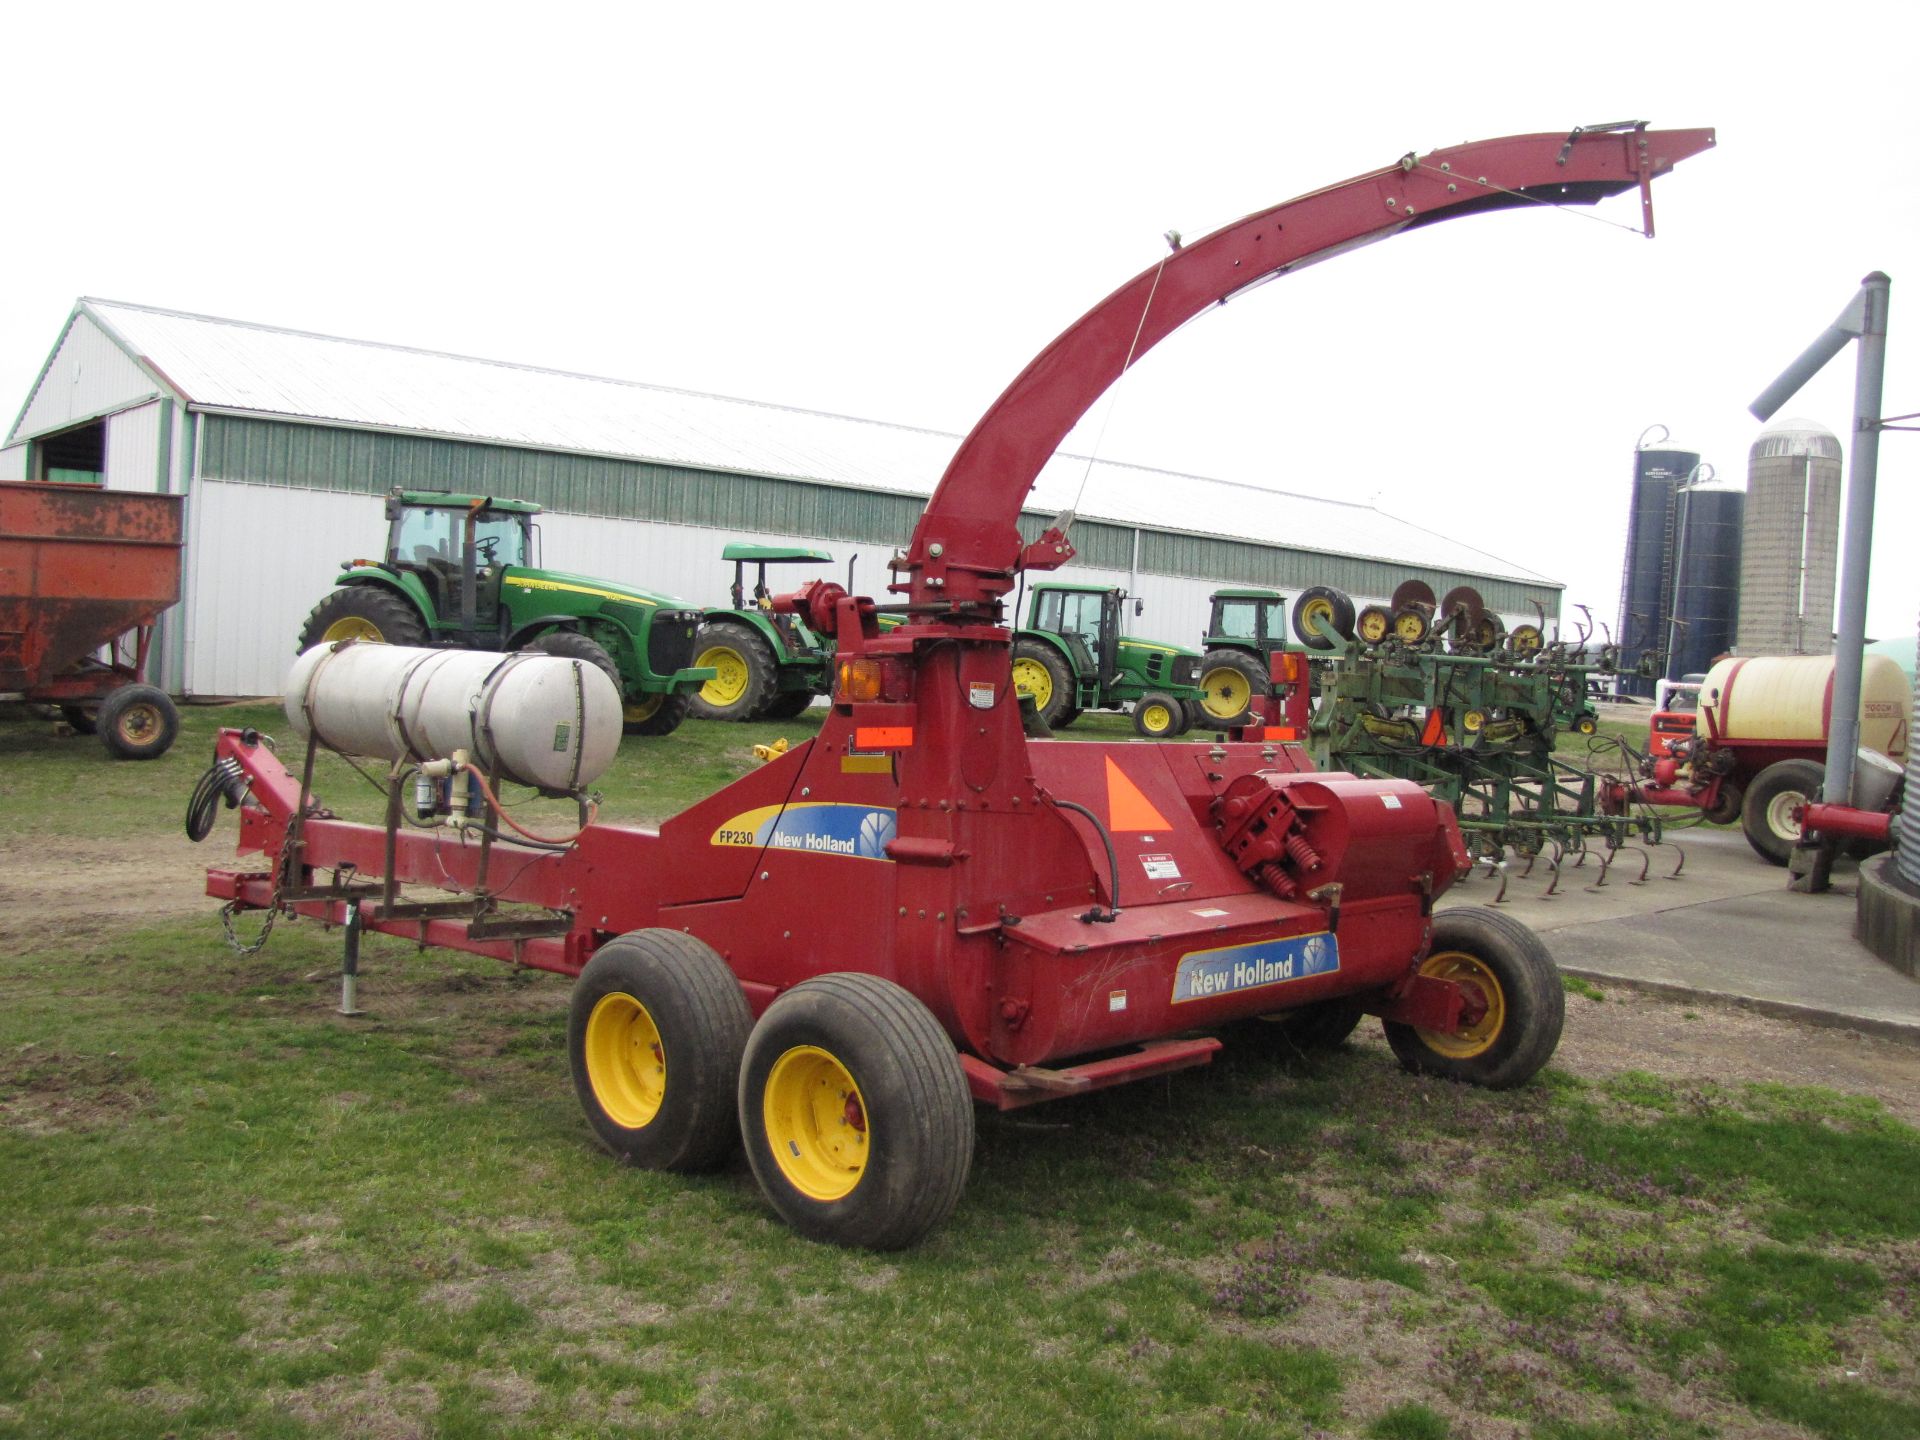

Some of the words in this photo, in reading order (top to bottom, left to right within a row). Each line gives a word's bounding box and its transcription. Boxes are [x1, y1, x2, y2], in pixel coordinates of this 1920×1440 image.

[719, 830, 753, 845] FP230
[774, 831, 802, 847] New
[805, 833, 855, 854] Holland
[1190, 969, 1229, 995] New
[1233, 953, 1293, 988] Holland
